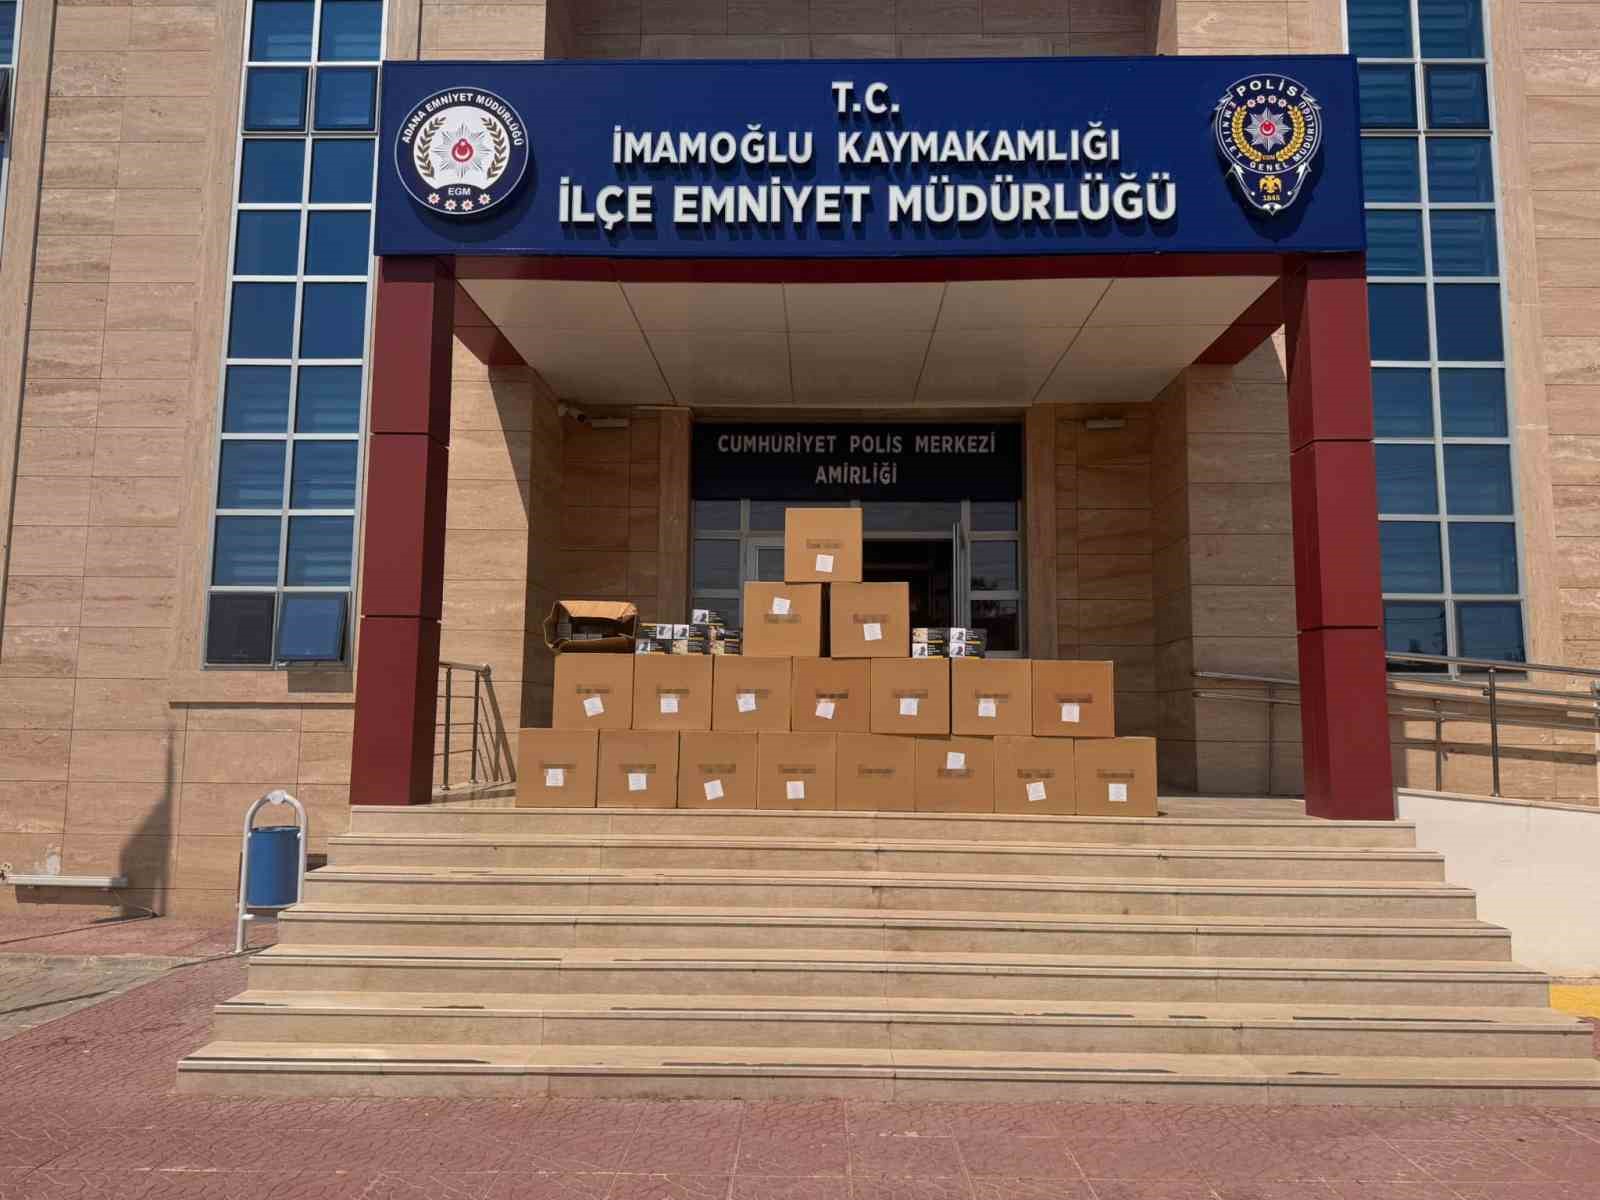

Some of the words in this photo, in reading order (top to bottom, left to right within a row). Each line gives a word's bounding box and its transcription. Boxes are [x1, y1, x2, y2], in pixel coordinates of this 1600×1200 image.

[831, 81, 900, 114] T.C.
[1236, 79, 1298, 97] POLİS
[401, 110, 427, 144] ADANA
[425, 93, 474, 112] EMNİYET
[475, 94, 524, 146] MÜDÜRLÜĞÜ
[612, 123, 814, 164] İMAMOĞLU
[838, 121, 1120, 164] KAYMAKAMLIĞI
[1249, 161, 1290, 171] GENEL
[447, 187, 472, 196] EGM
[559, 176, 653, 230] İLÇE
[673, 176, 870, 223] EMNİYET
[888, 172, 1177, 223] MÜDÜRLÜĞÜ
[717, 432, 838, 454] CUMHURİYET
[849, 433, 903, 454] POLİS
[914, 432, 996, 454] MERKEZİ
[815, 461, 898, 485] AMİRLİĞİ
